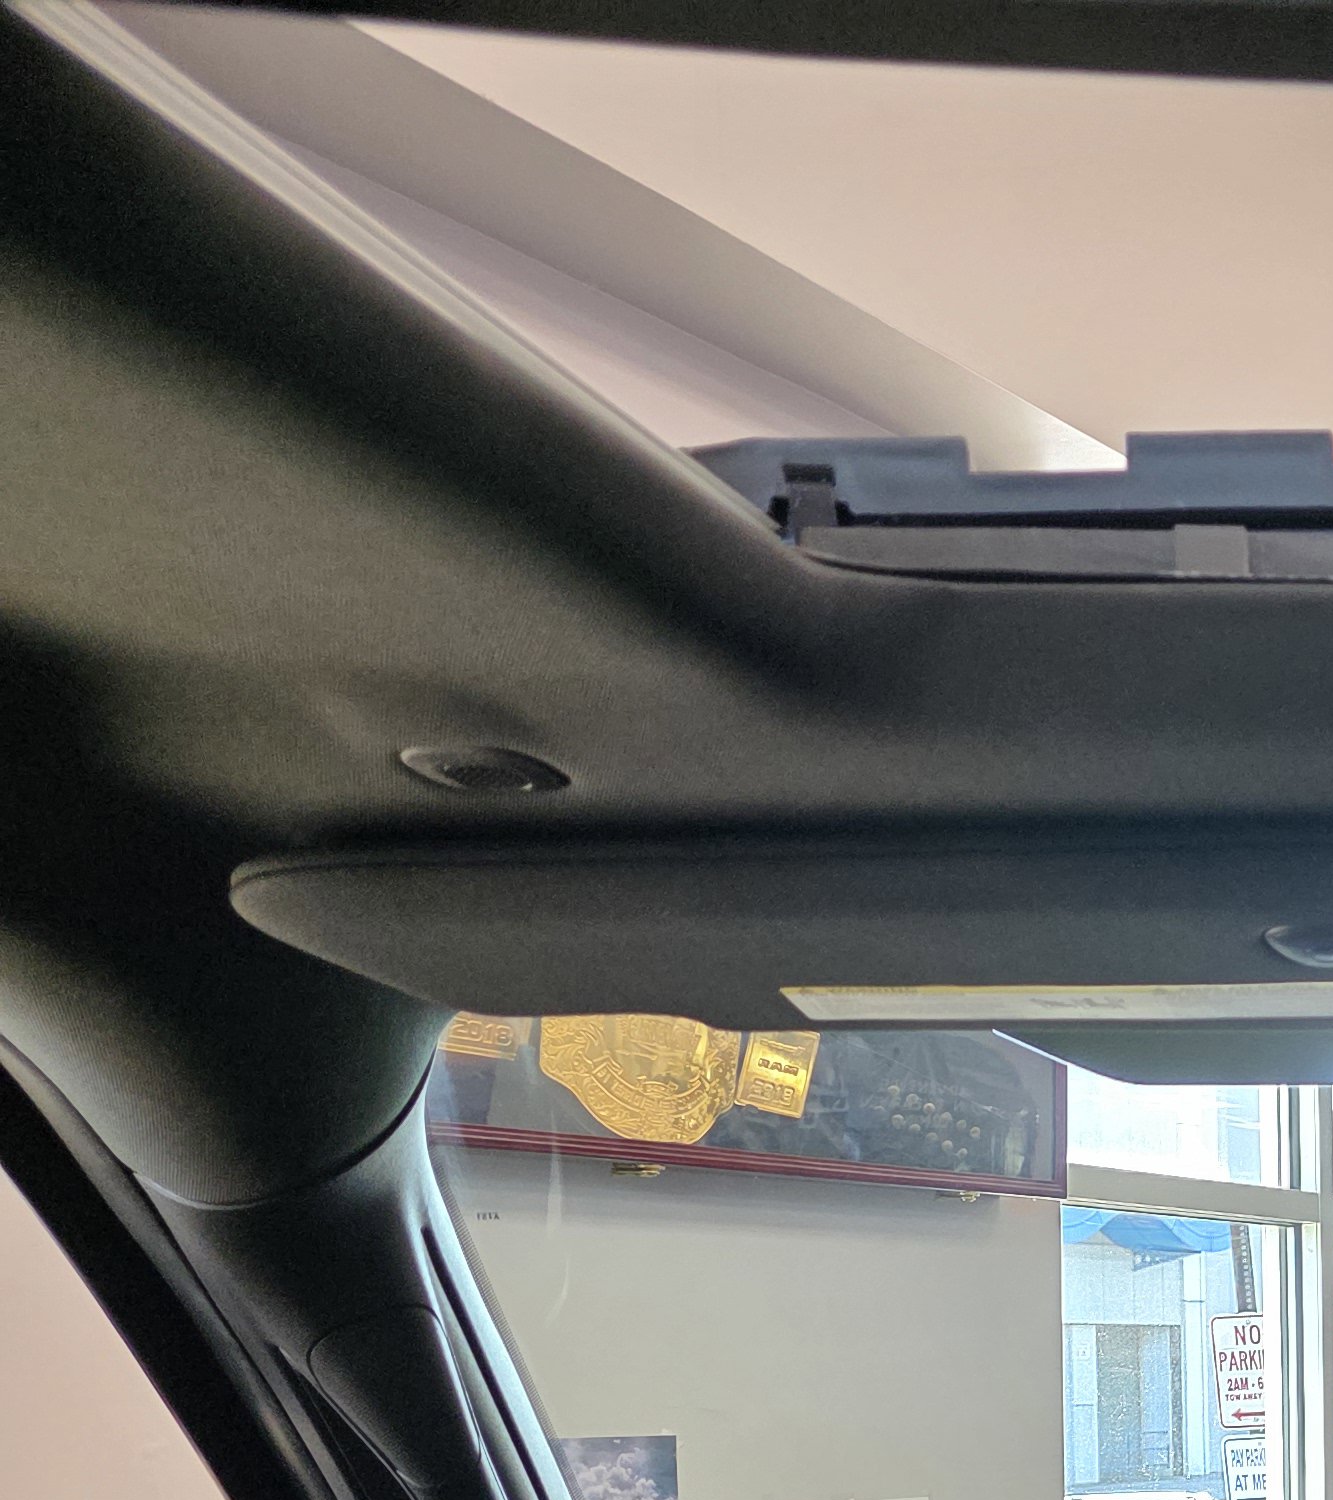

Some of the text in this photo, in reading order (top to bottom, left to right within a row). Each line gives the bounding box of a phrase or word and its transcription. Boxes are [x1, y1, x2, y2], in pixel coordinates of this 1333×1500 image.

[757, 1057, 799, 1076] RAM
[1234, 1324, 1260, 1345] NO
[1219, 1349, 1265, 1372] PARKI
[1228, 1378, 1249, 1391] 2AM
[1231, 1449, 1244, 1467] PAY
[1235, 1474, 1266, 1491] AT ME
